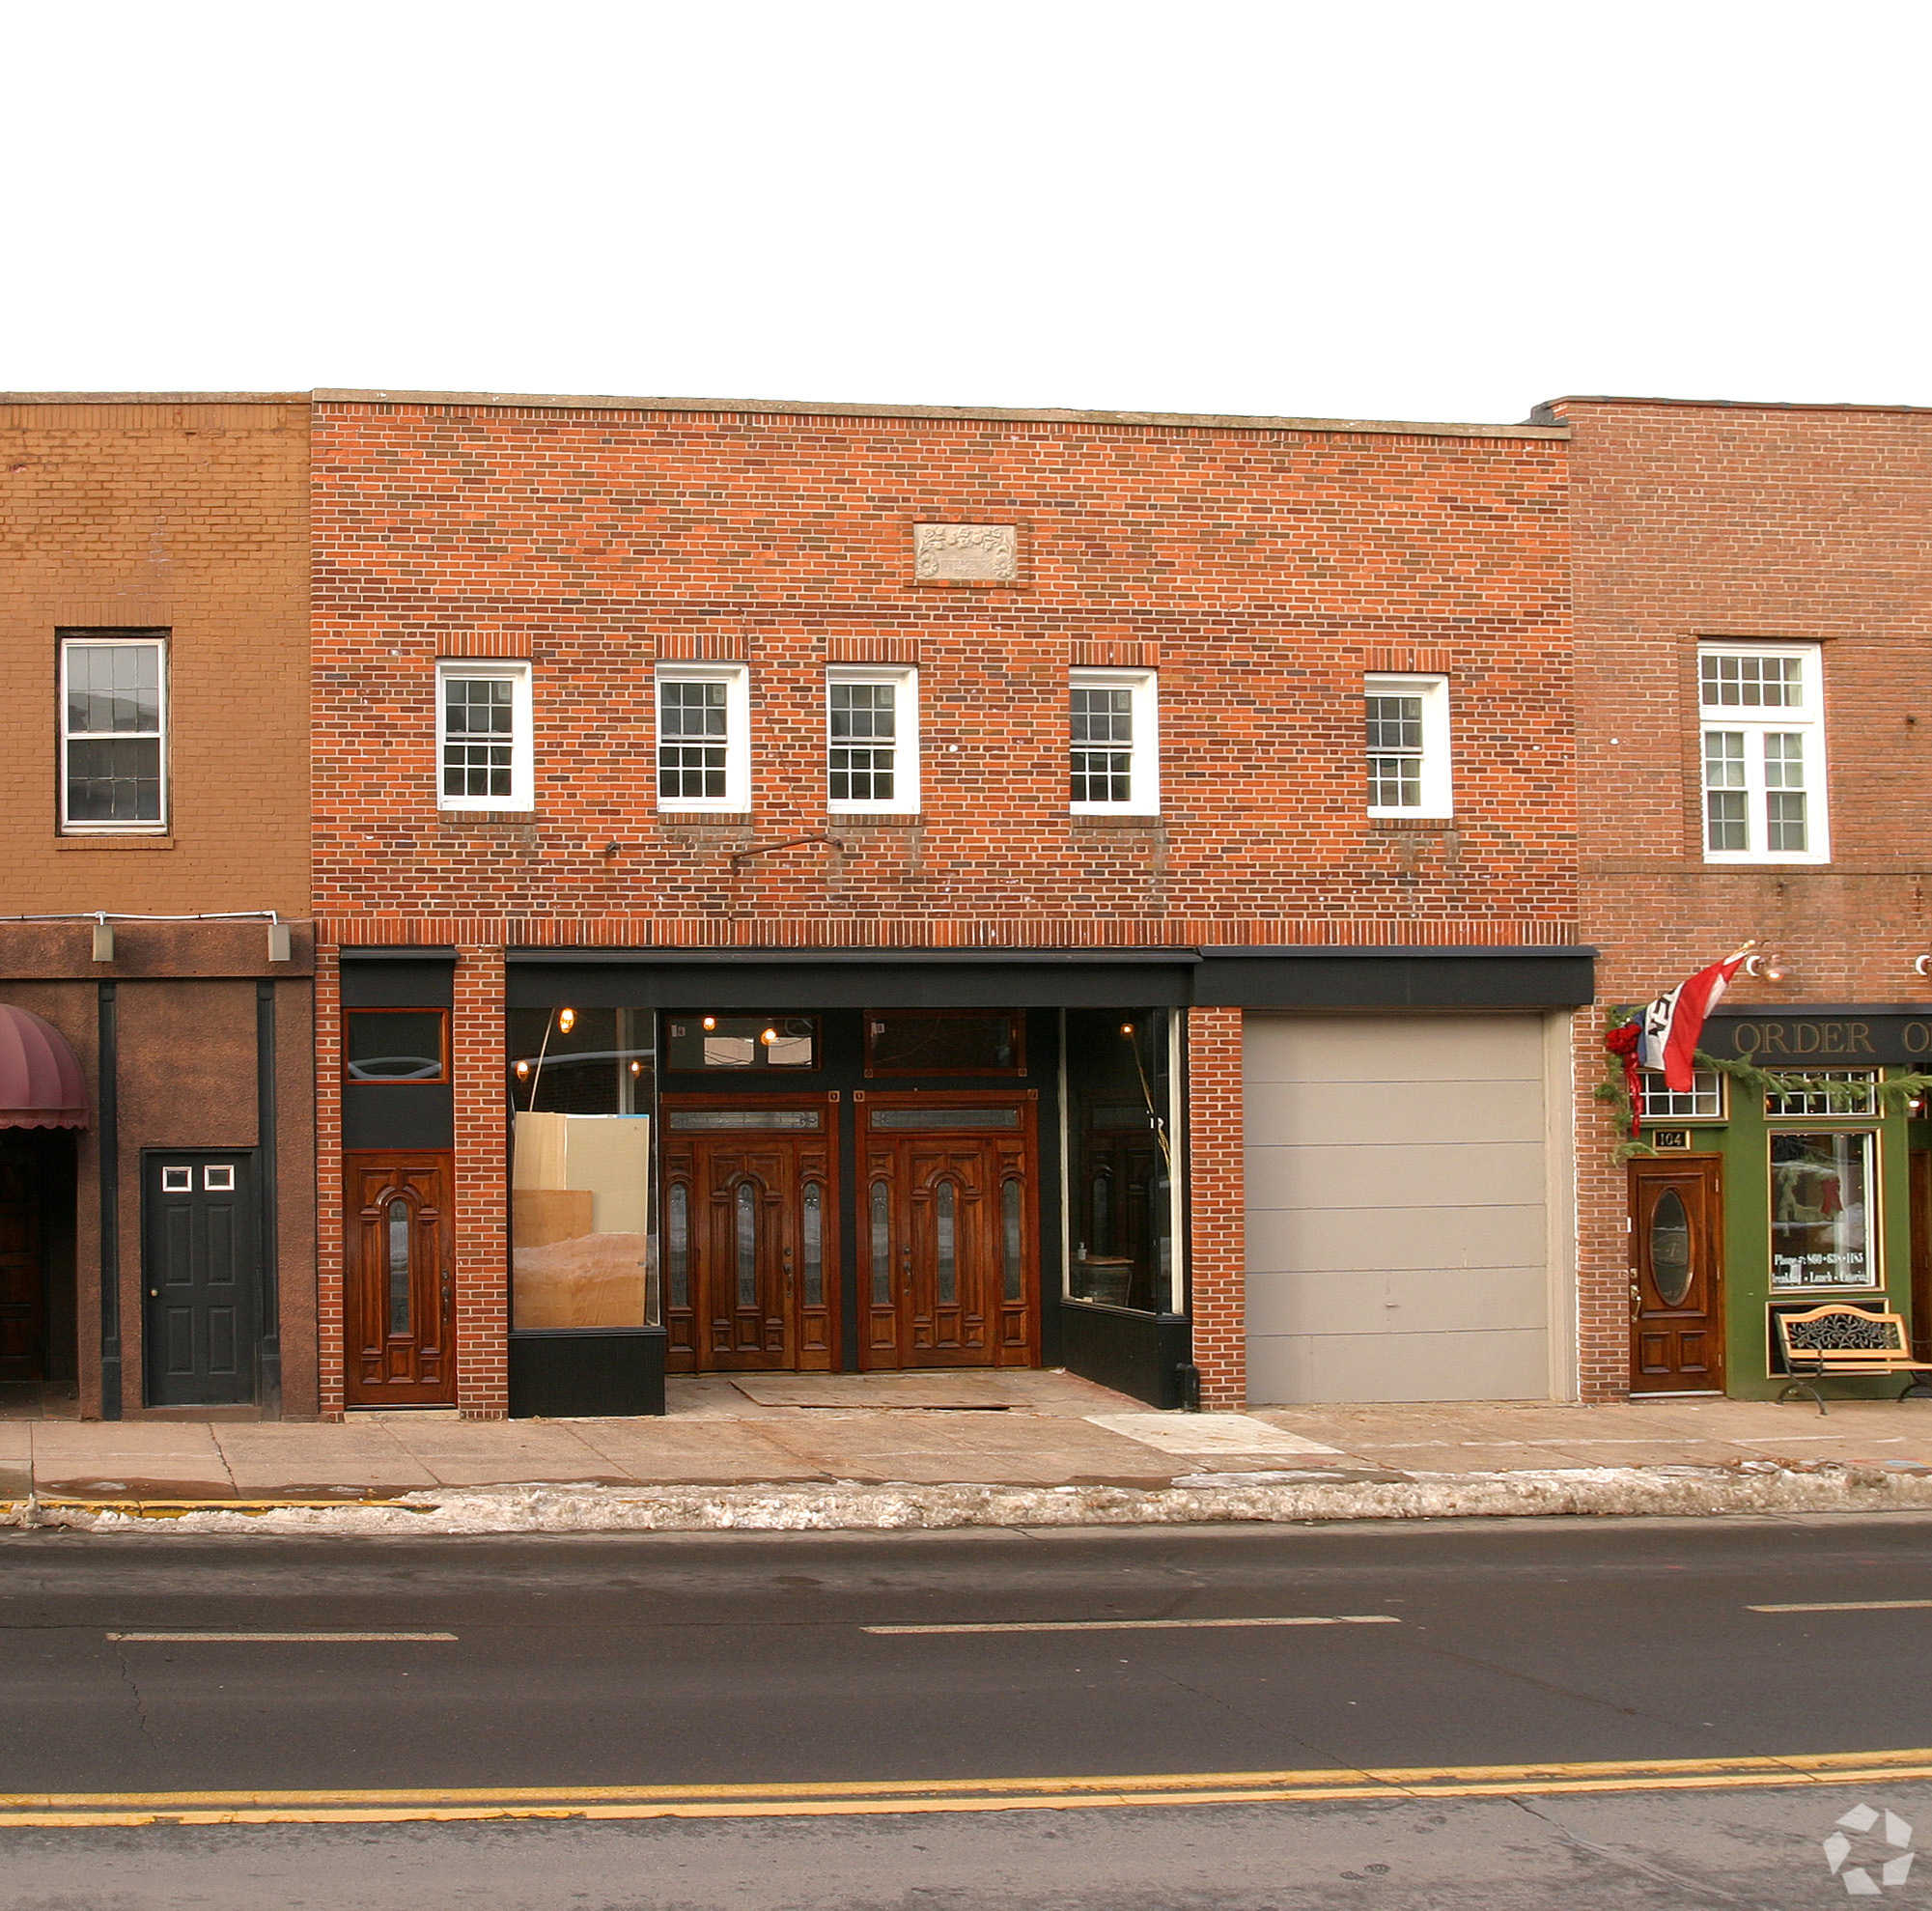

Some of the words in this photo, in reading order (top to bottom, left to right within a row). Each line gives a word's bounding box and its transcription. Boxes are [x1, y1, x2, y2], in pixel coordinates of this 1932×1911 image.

[1732, 1022, 1876, 1054] ORDER
[1903, 1022, 1932, 1054] O
[1660, 1133, 1681, 1146] 104
